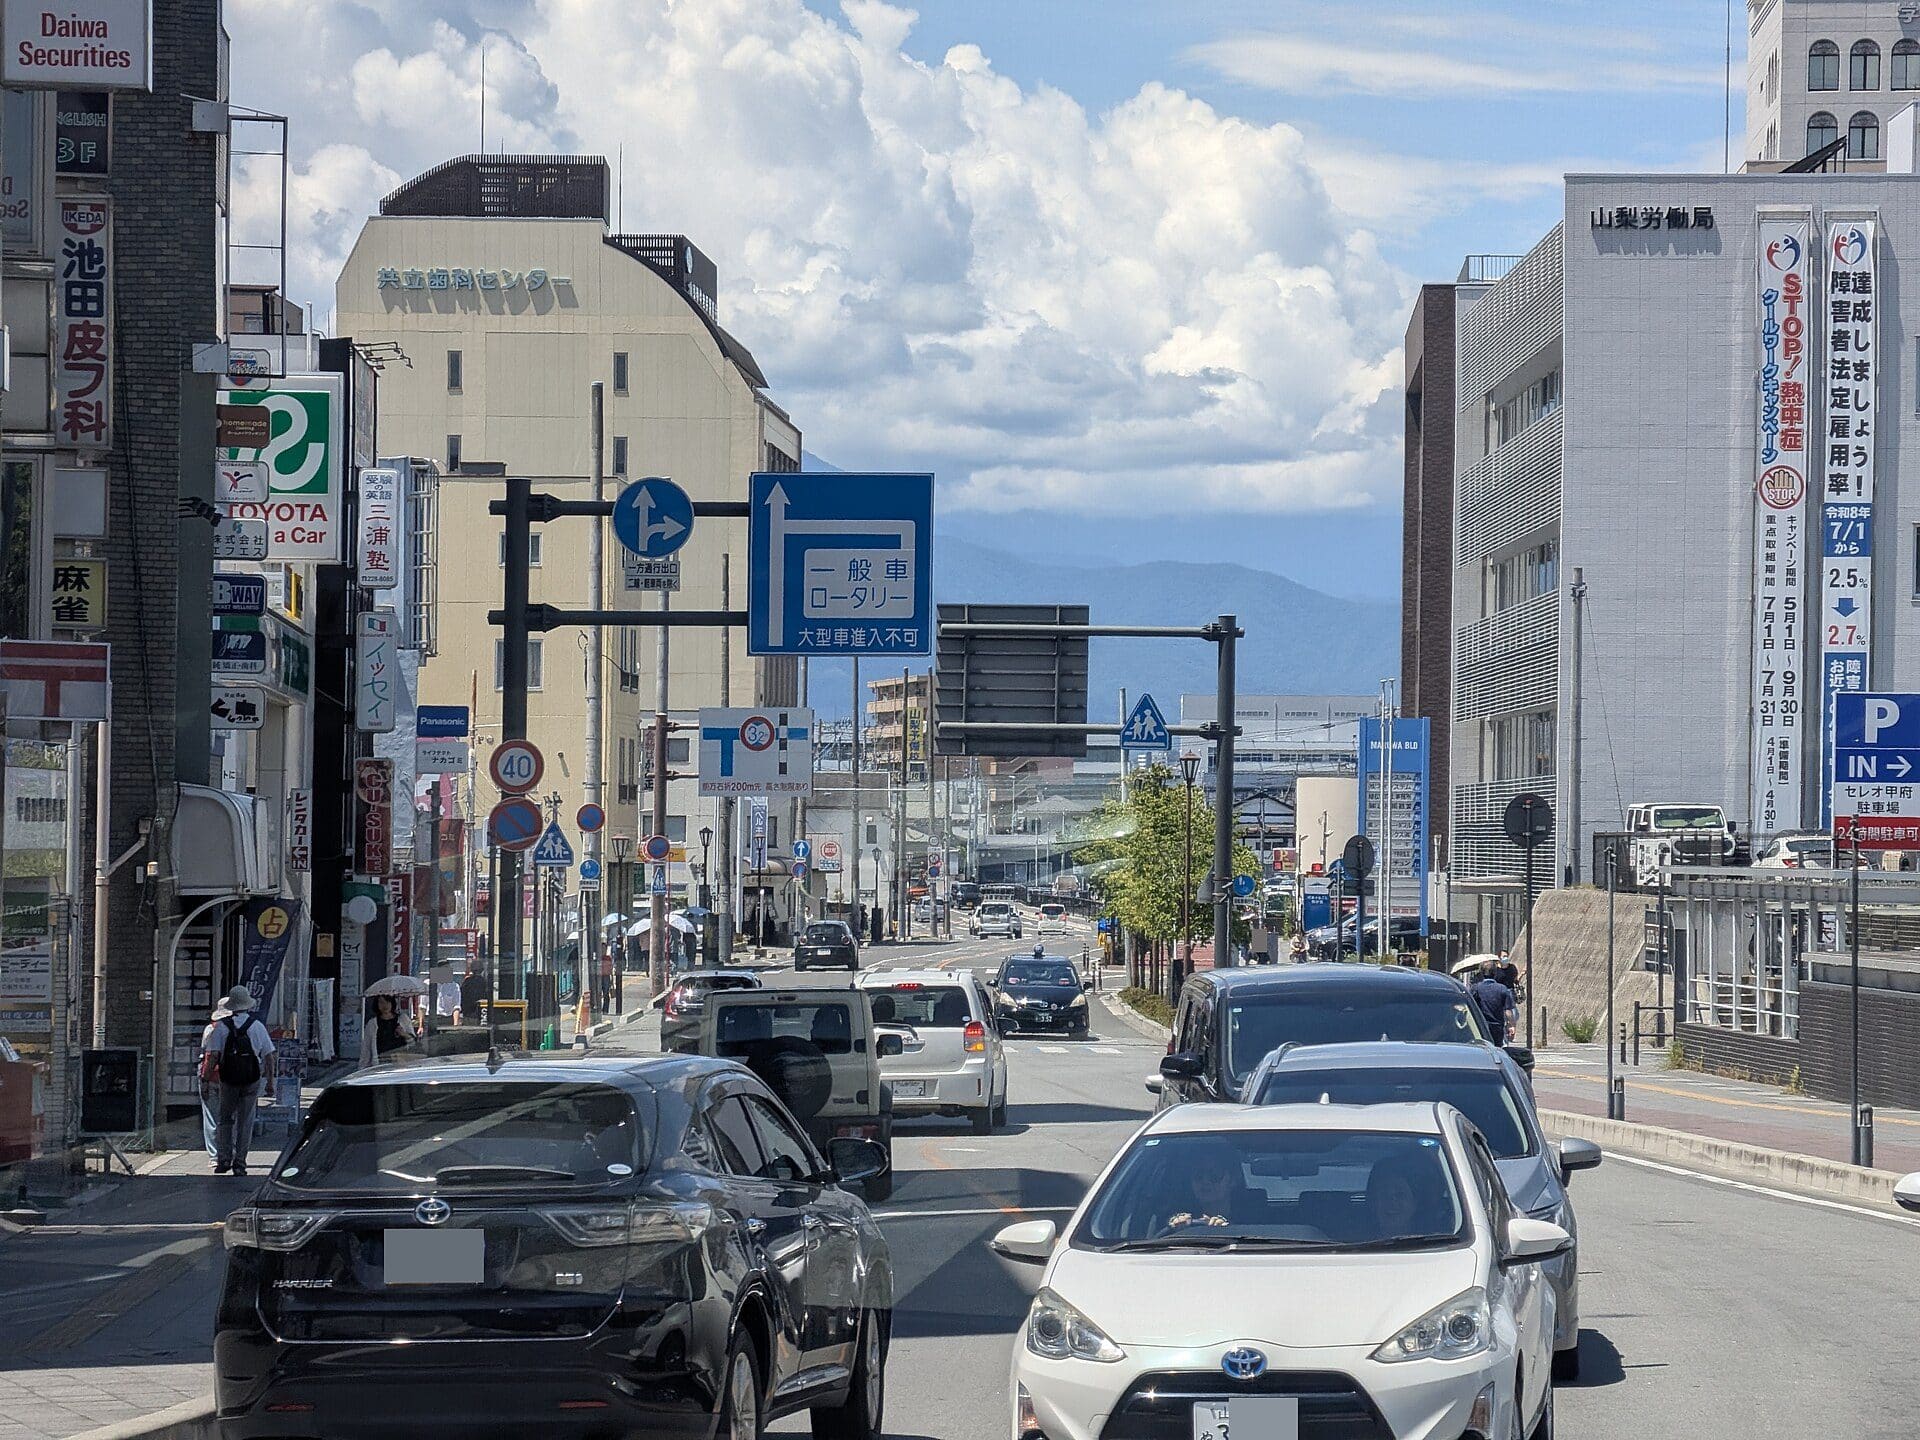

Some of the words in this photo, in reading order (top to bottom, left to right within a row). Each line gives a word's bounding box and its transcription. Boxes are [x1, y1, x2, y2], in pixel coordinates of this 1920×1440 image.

[41, 12, 108, 39] Daiwa
[18, 41, 131, 69] Securities
[64, 211, 104, 224] IKEDA
[1590, 206, 1714, 231] 山梨労働局
[377, 267, 572, 291] 共立歯科センター
[62, 238, 108, 441] 池田皮フ科
[1762, 289, 1779, 464] クールワークキャンペーン
[1828, 271, 1851, 496] 障害者法定雇用率
[1851, 271, 1873, 496] 達成しましょう!
[1767, 488, 1795, 501] STOP
[1825, 506, 1871, 519] 令和8年
[274, 530, 286, 543] a
[290, 527, 327, 543] Car
[365, 504, 391, 572] 三浦塾
[1830, 522, 1865, 541] 7/1
[1834, 543, 1860, 555] から
[628, 562, 678, 575] 一方通行出口
[810, 558, 909, 582] 一般車
[1828, 568, 1868, 589] 2.5%
[52, 565, 90, 623] 麻雀
[811, 587, 909, 609] ロータリー
[798, 627, 919, 647] 大型車進入不可
[1827, 625, 1866, 646] 2.7%
[363, 641, 389, 719] イッセイ
[420, 717, 465, 726] Panasonic
[1864, 699, 1900, 744] P
[502, 755, 532, 778] 40
[1849, 756, 1877, 778] IN
[1845, 786, 1914, 799] セレオ甲府
[1857, 801, 1900, 815] 駐車場
